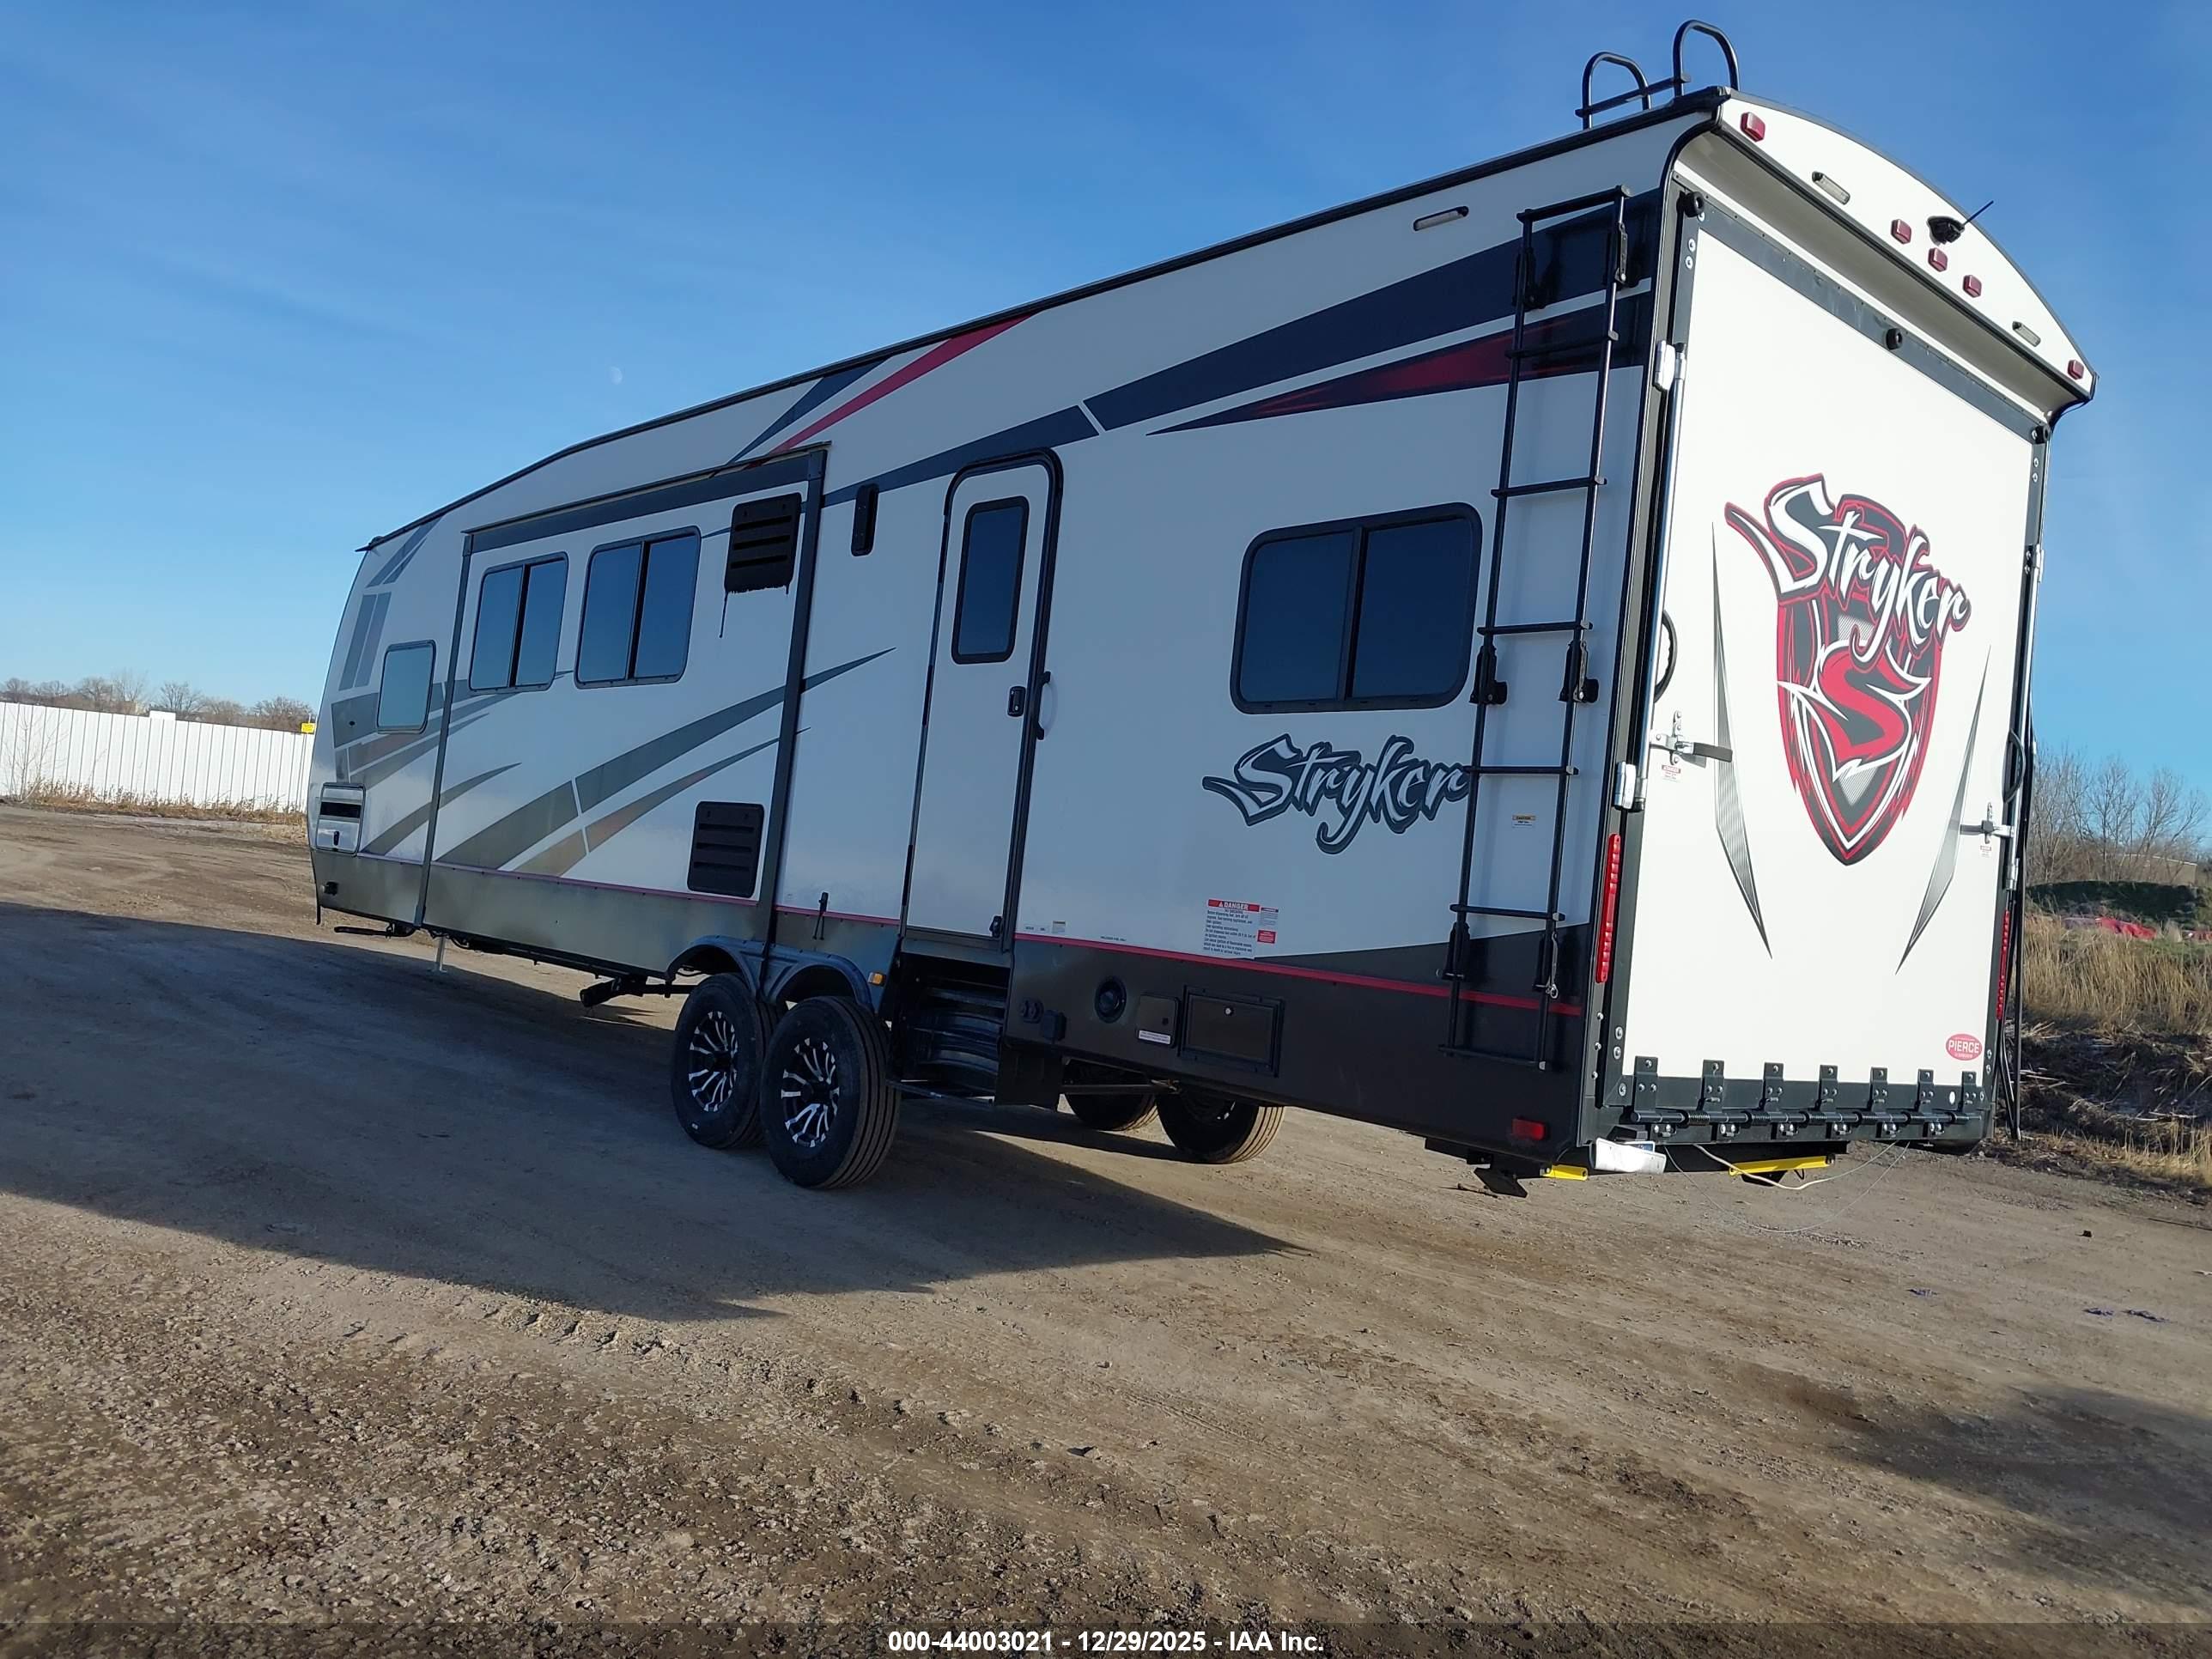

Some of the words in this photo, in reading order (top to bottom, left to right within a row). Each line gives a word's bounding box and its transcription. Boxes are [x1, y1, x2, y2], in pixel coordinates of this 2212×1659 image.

[1724, 473, 1972, 673] Stryker
[1202, 733, 1470, 854] Stryker
[1224, 902, 1249, 910] DANGER
[1948, 1039, 1979, 1054] PIERCE
